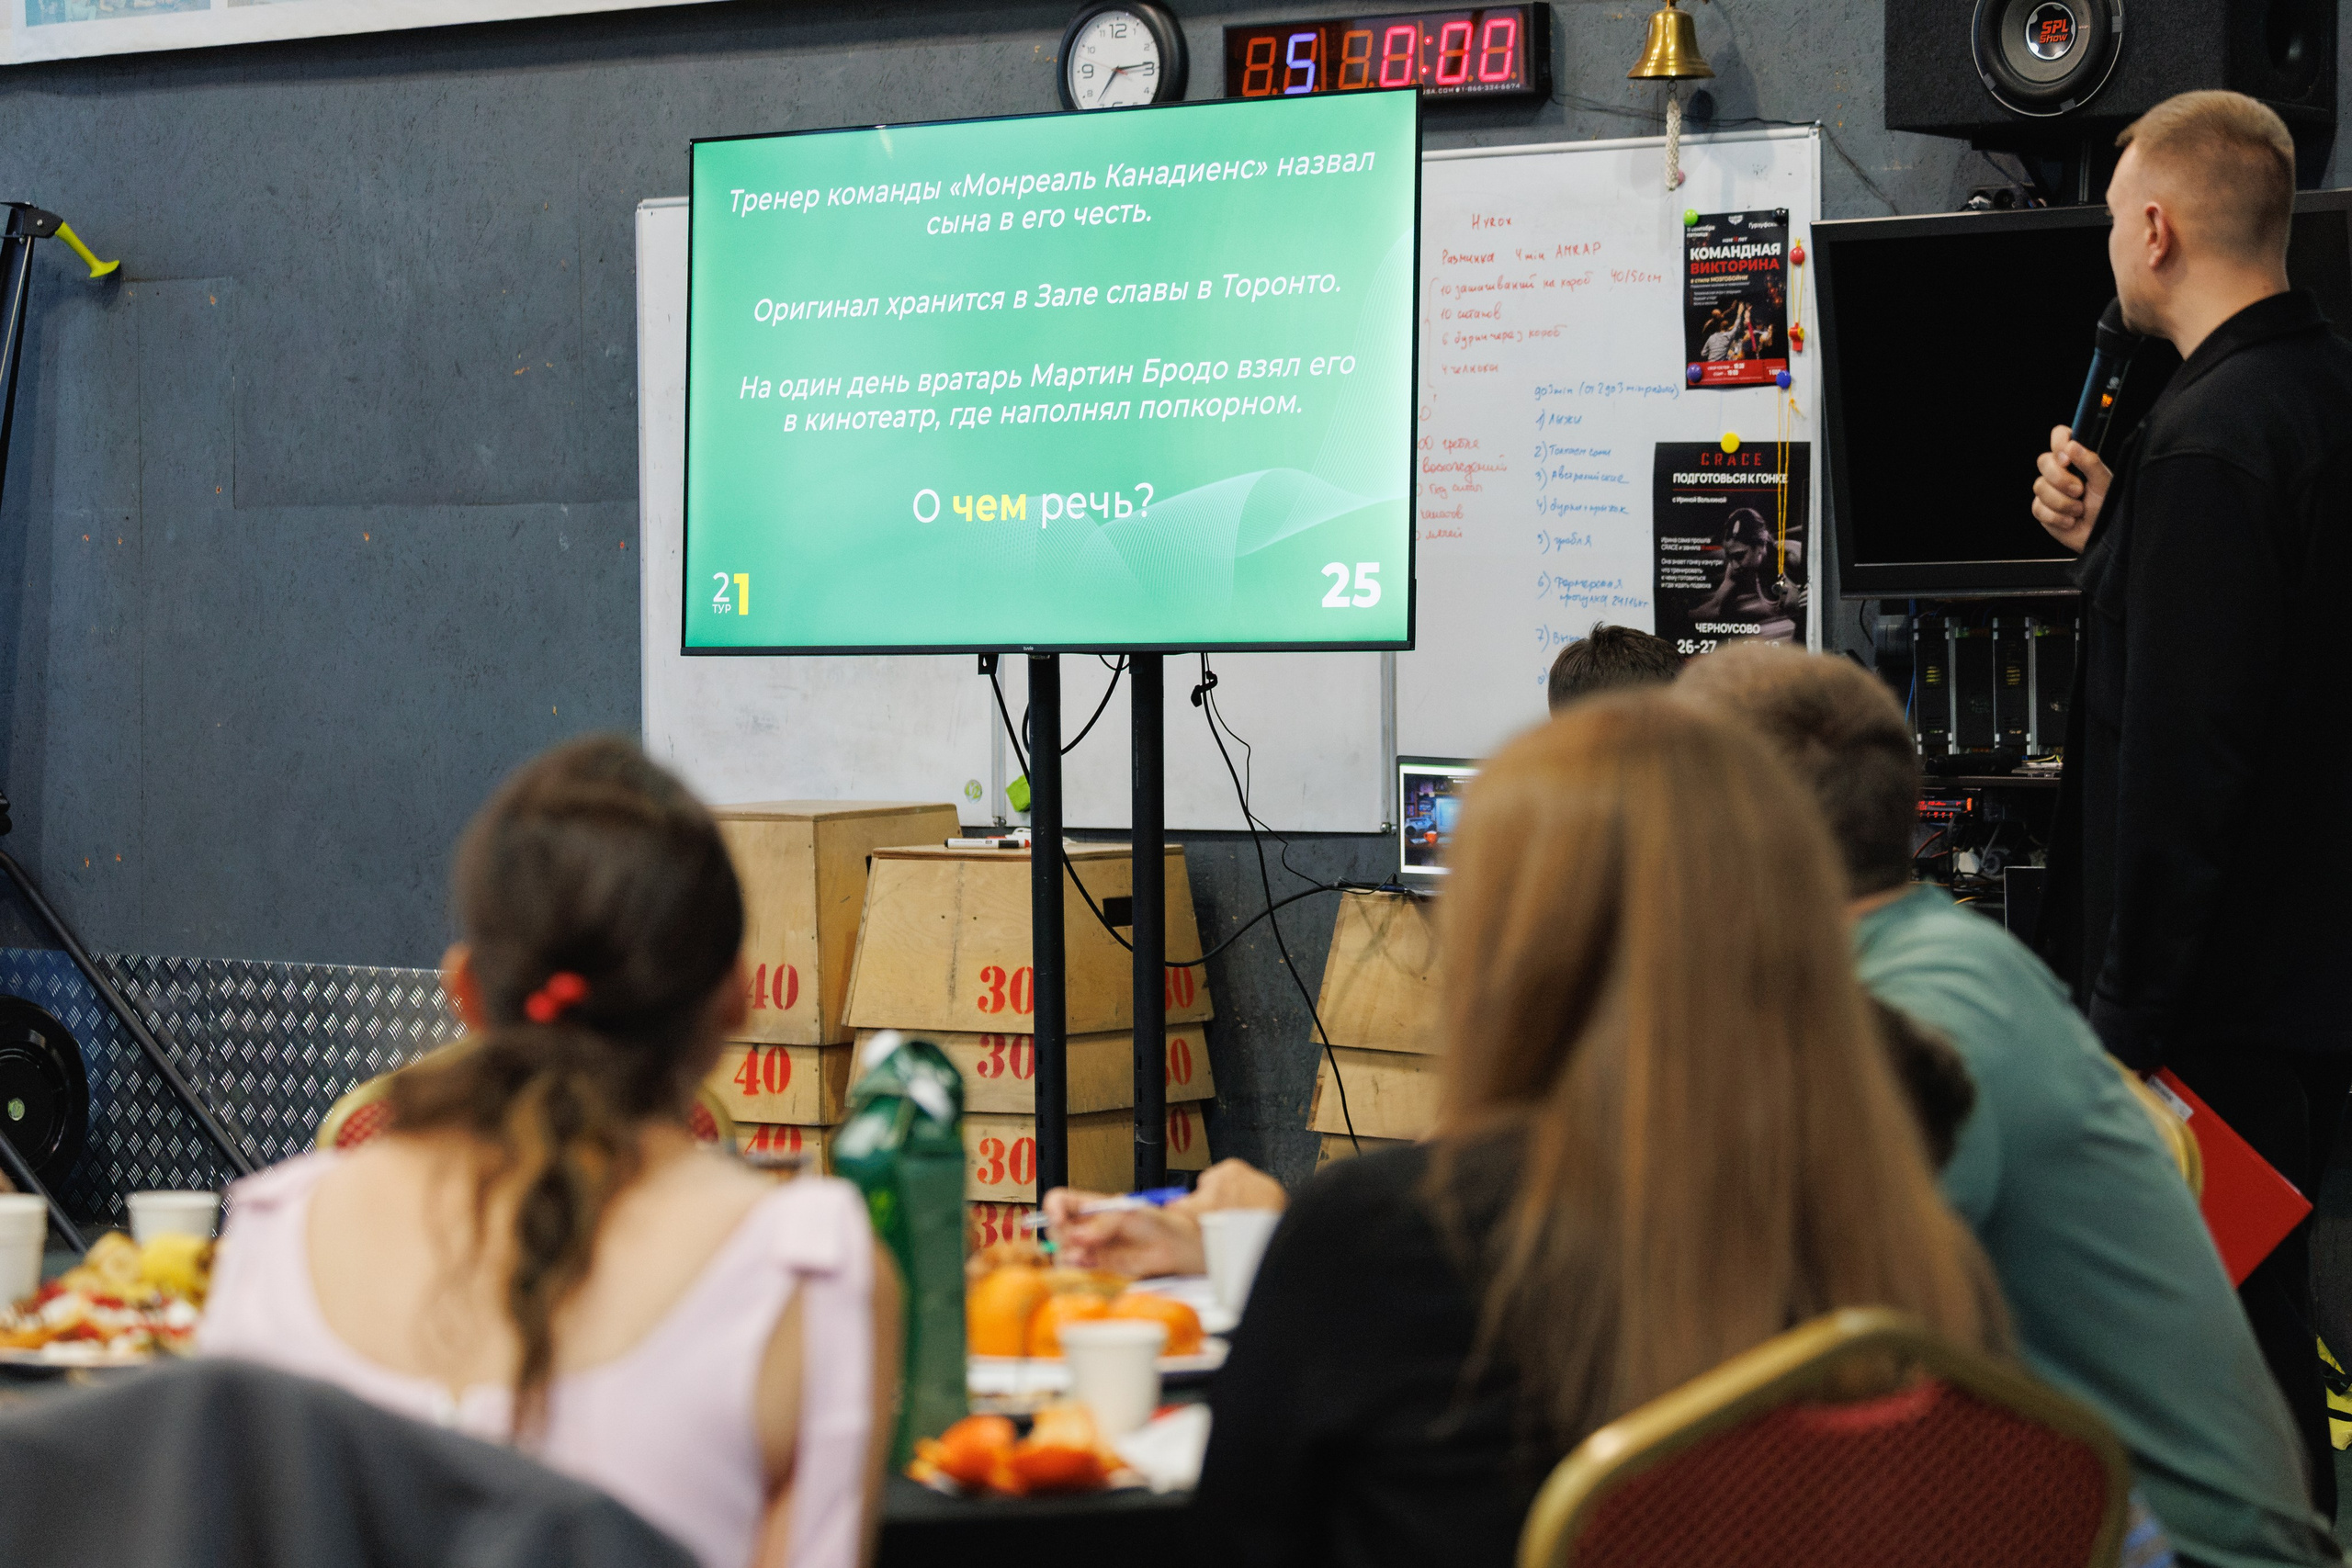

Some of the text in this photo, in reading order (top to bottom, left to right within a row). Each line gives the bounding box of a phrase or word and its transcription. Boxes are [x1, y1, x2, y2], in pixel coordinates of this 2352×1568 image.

[1099, 29, 1105, 38] 11
[1109, 23, 1127, 39] 12
[2041, 18, 2069, 35] SPL
[1087, 46, 1096, 54] 10
[1143, 43, 1150, 51] 2
[1081, 63, 1094, 79] 9
[1142, 62, 1155, 76] 3
[1086, 89, 1093, 97] 8
[1143, 86, 1149, 95] 4
[729, 151, 1375, 218] Тренер команды «Монреаль Канадиенс» назвал
[926, 202, 1152, 235] сына в его честь.
[1555, 242, 1601, 259] AMRAP
[1690, 243, 1781, 261] КОМАНДНАЯ
[1690, 258, 1781, 275] ВИКТОРИНА
[1441, 284, 1452, 296] 10
[753, 273, 1341, 327] Оригинал хранится в Зале славы в Торонто.
[1441, 309, 1453, 321] 10
[739, 355, 1356, 401] На один день вратарь Мартин Бродо взял его
[784, 393, 1303, 434] в кинотеатр, где наполнял попкорном.
[1701, 452, 1762, 466] CRACE
[1672, 472, 1789, 485] ПОДГОТОВЬСЯ К ГОНКЕ
[912, 482, 1155, 529] О чем речь?
[1320, 561, 1382, 608] 25
[712, 603, 732, 614] ТУР
[1695, 622, 1761, 635] ЧЕРНОУСОВО
[1677, 638, 1717, 654] 26-27
[744, 963, 799, 1010] 40
[977, 965, 1035, 1015] 30
[977, 1033, 1035, 1080] 30
[734, 1046, 792, 1096] 40
[977, 1137, 1037, 1186] 30
